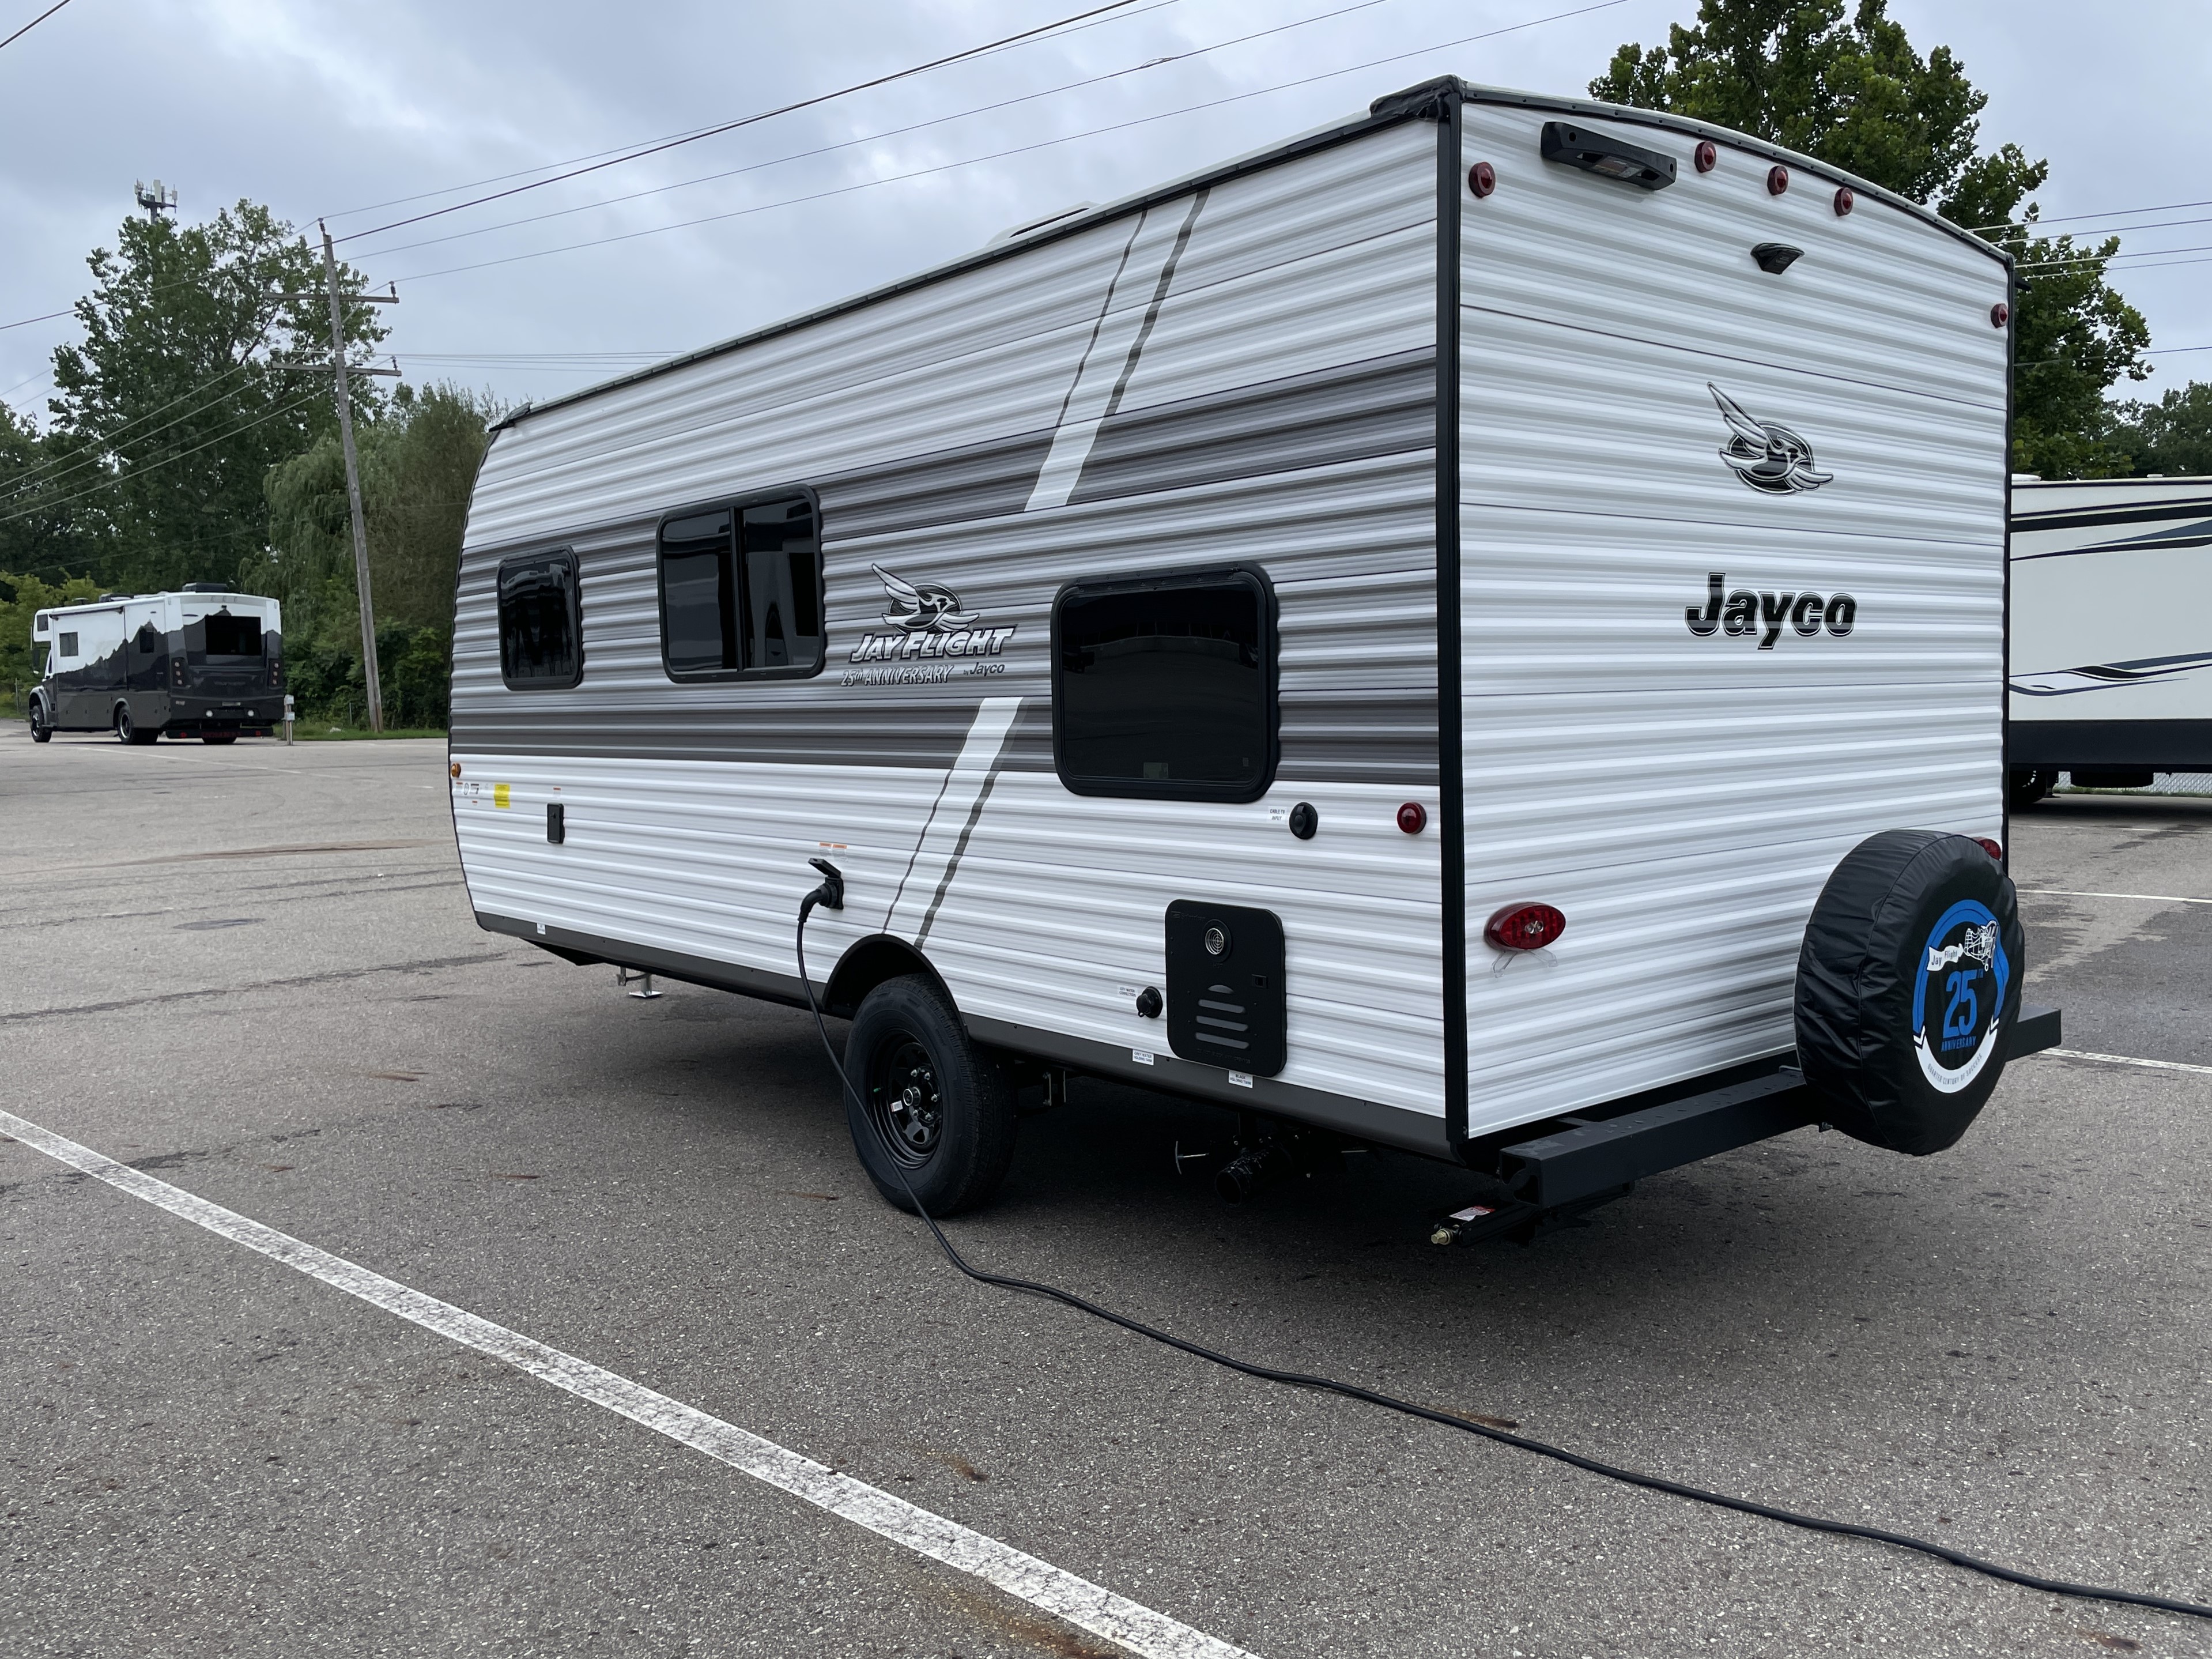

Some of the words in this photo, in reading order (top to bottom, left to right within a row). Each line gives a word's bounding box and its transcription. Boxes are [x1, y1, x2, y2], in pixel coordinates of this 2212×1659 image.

[1685, 572, 1858, 650] Jayco
[848, 632, 907, 663] JAY
[900, 624, 1018, 660] FLIGHT
[840, 669, 863, 686] 25th
[864, 664, 954, 686] ANNIVERSARY
[969, 662, 1005, 677] Jayco
[1931, 955, 1942, 967] Jay
[1945, 949, 1958, 960] Flight
[1941, 1035, 1976, 1052] ANNIVERSARY
[1927, 1062, 1942, 1083] QUARTER
[1942, 1076, 1960, 1085] CENTURY
[1961, 1073, 1965, 1081] OF
[1966, 1053, 1983, 1077] SUCCESS
